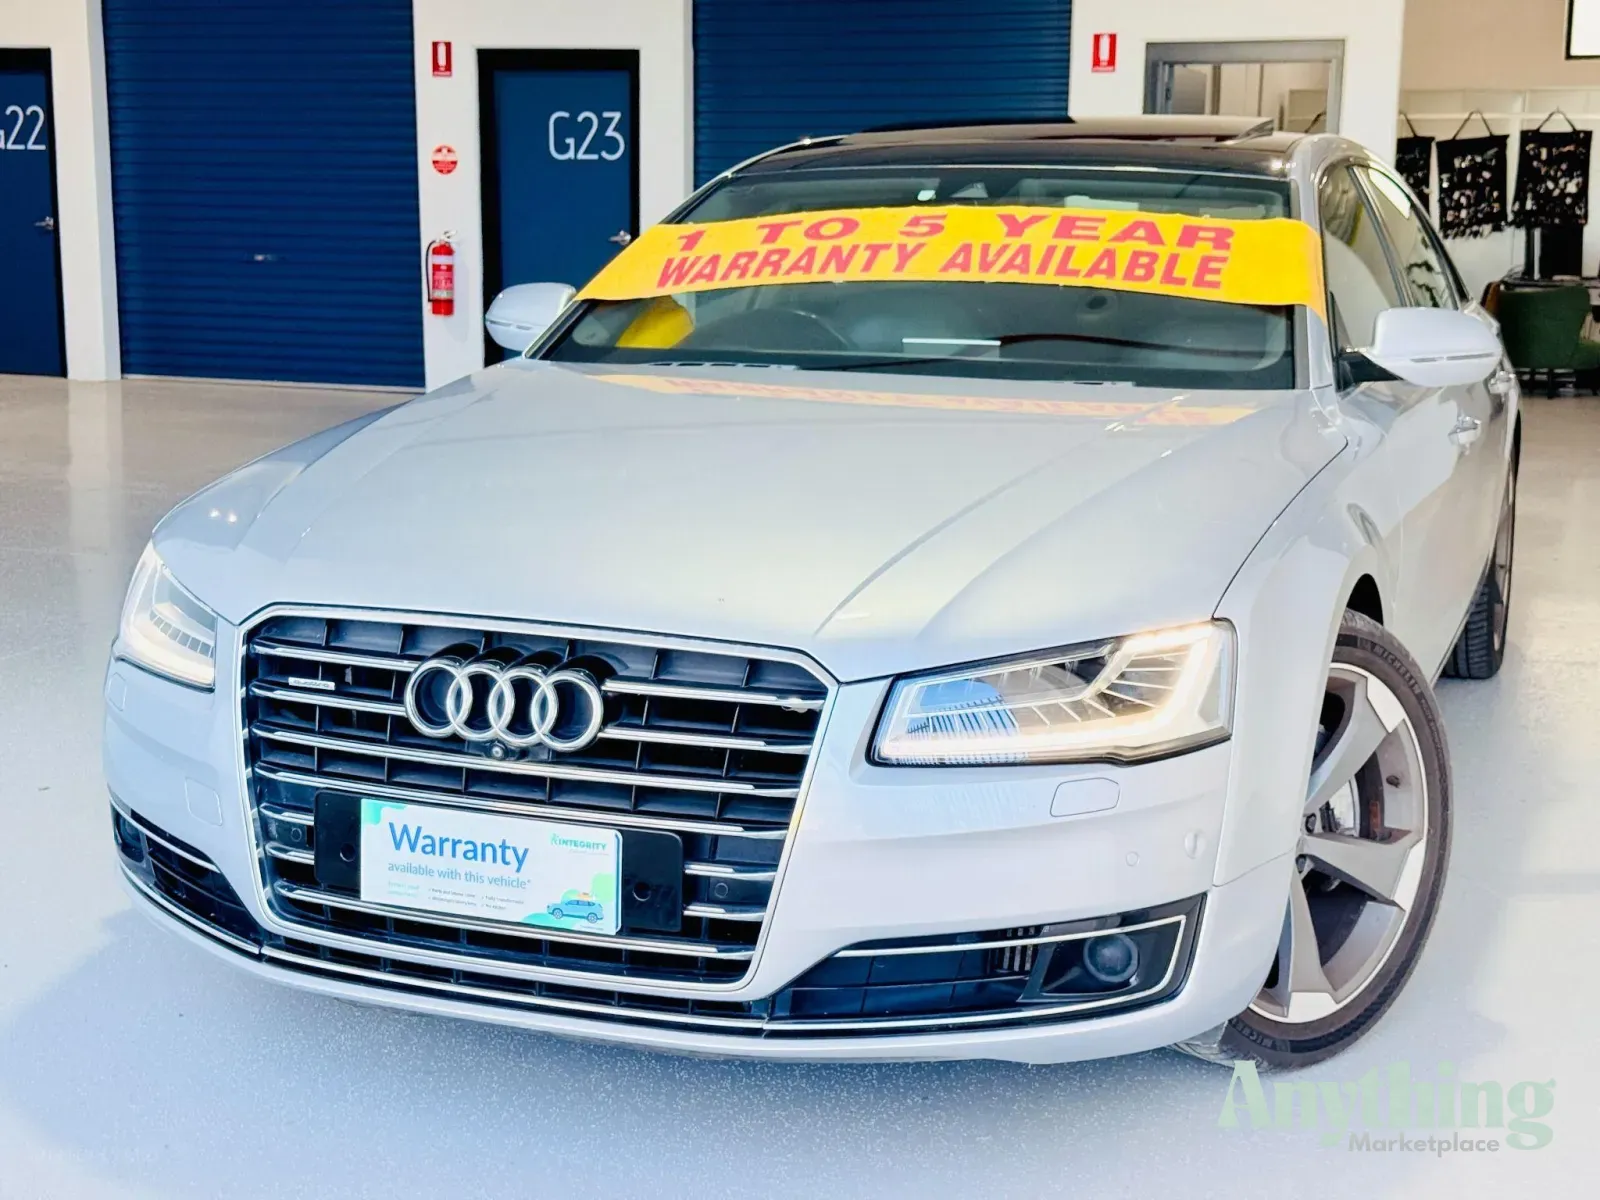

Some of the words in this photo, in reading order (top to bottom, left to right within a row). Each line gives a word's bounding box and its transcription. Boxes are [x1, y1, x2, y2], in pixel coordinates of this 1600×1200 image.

[0, 105, 46, 150] 22
[549, 111, 625, 160] G23
[677, 230, 707, 252] 1
[757, 217, 860, 244] TO
[899, 215, 948, 238] 5
[996, 214, 1235, 250] YEAR
[656, 242, 927, 289] WARRANTY
[938, 243, 1229, 289] AVAILABLE
[389, 822, 529, 873] Warranty
[559, 838, 607, 851] INTEGRITY
[388, 862, 434, 877] available
[437, 868, 462, 881] with
[464, 871, 485, 884] this
